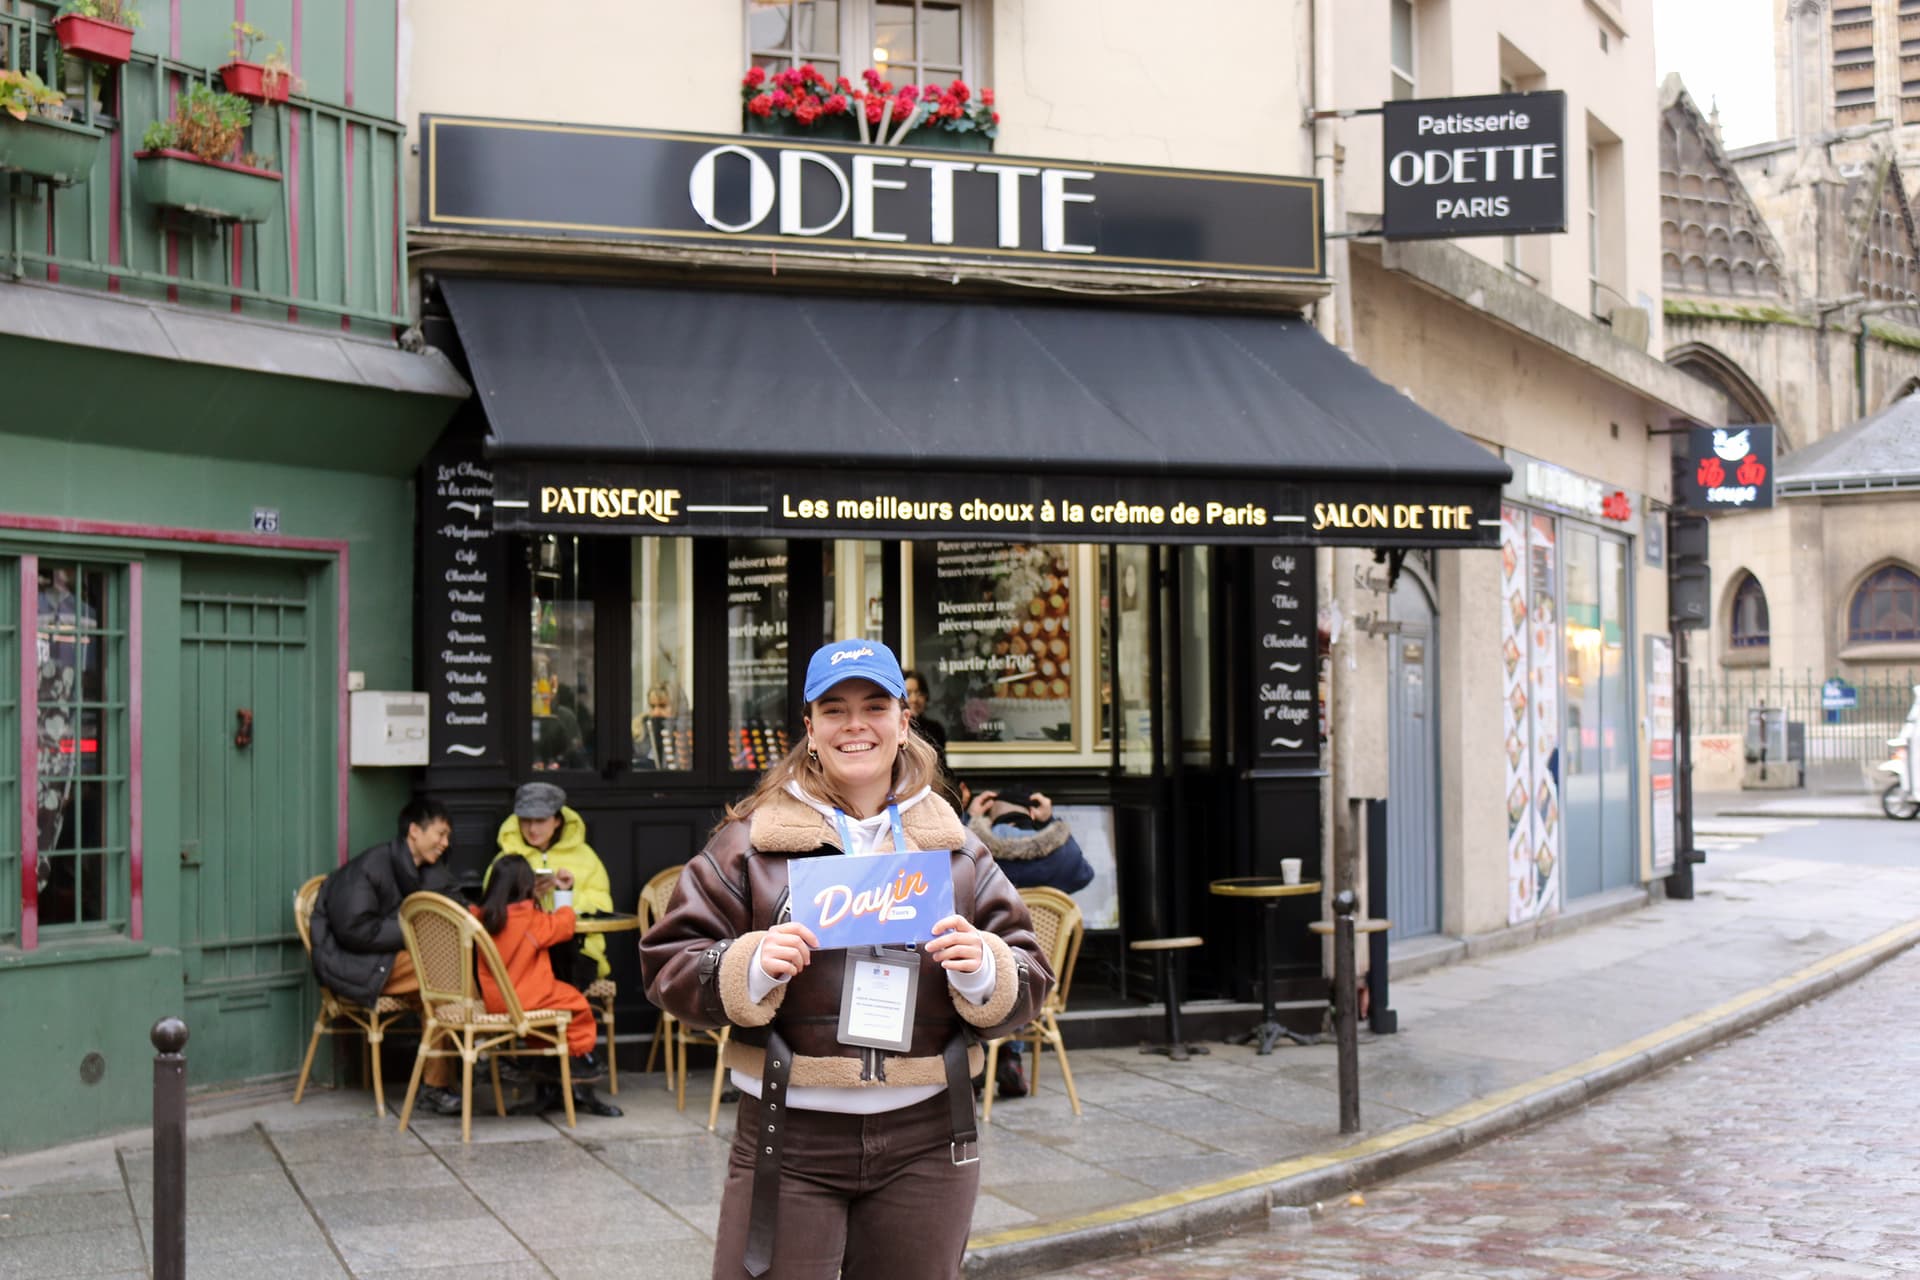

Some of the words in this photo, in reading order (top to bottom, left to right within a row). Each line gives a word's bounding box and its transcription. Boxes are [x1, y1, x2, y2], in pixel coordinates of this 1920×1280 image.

[1418, 110, 1531, 135] Patisserie
[1389, 143, 1557, 187] ODETTE
[689, 145, 1096, 254] ODETTE
[1436, 196, 1510, 220] PARIS
[541, 487, 681, 523] PATISSERIE
[782, 494, 830, 519] Les
[836, 495, 954, 521] meilleurs
[959, 498, 1035, 522] choux
[1040, 499, 1056, 523] à
[1062, 499, 1085, 523] la
[1090, 500, 1165, 525] crême
[1170, 501, 1201, 525] de
[1206, 502, 1267, 526] Paris
[1312, 503, 1389, 531] SALON
[1393, 504, 1425, 530] DE
[1429, 505, 1473, 531] THE
[254, 511, 278, 531] 75
[1272, 556, 1296, 574] Café
[1263, 634, 1308, 648] Chocolat
[949, 656, 986, 675] partir
[987, 654, 1006, 671] de
[1259, 683, 1292, 701] Salle
[814, 869, 929, 929] Dayin
